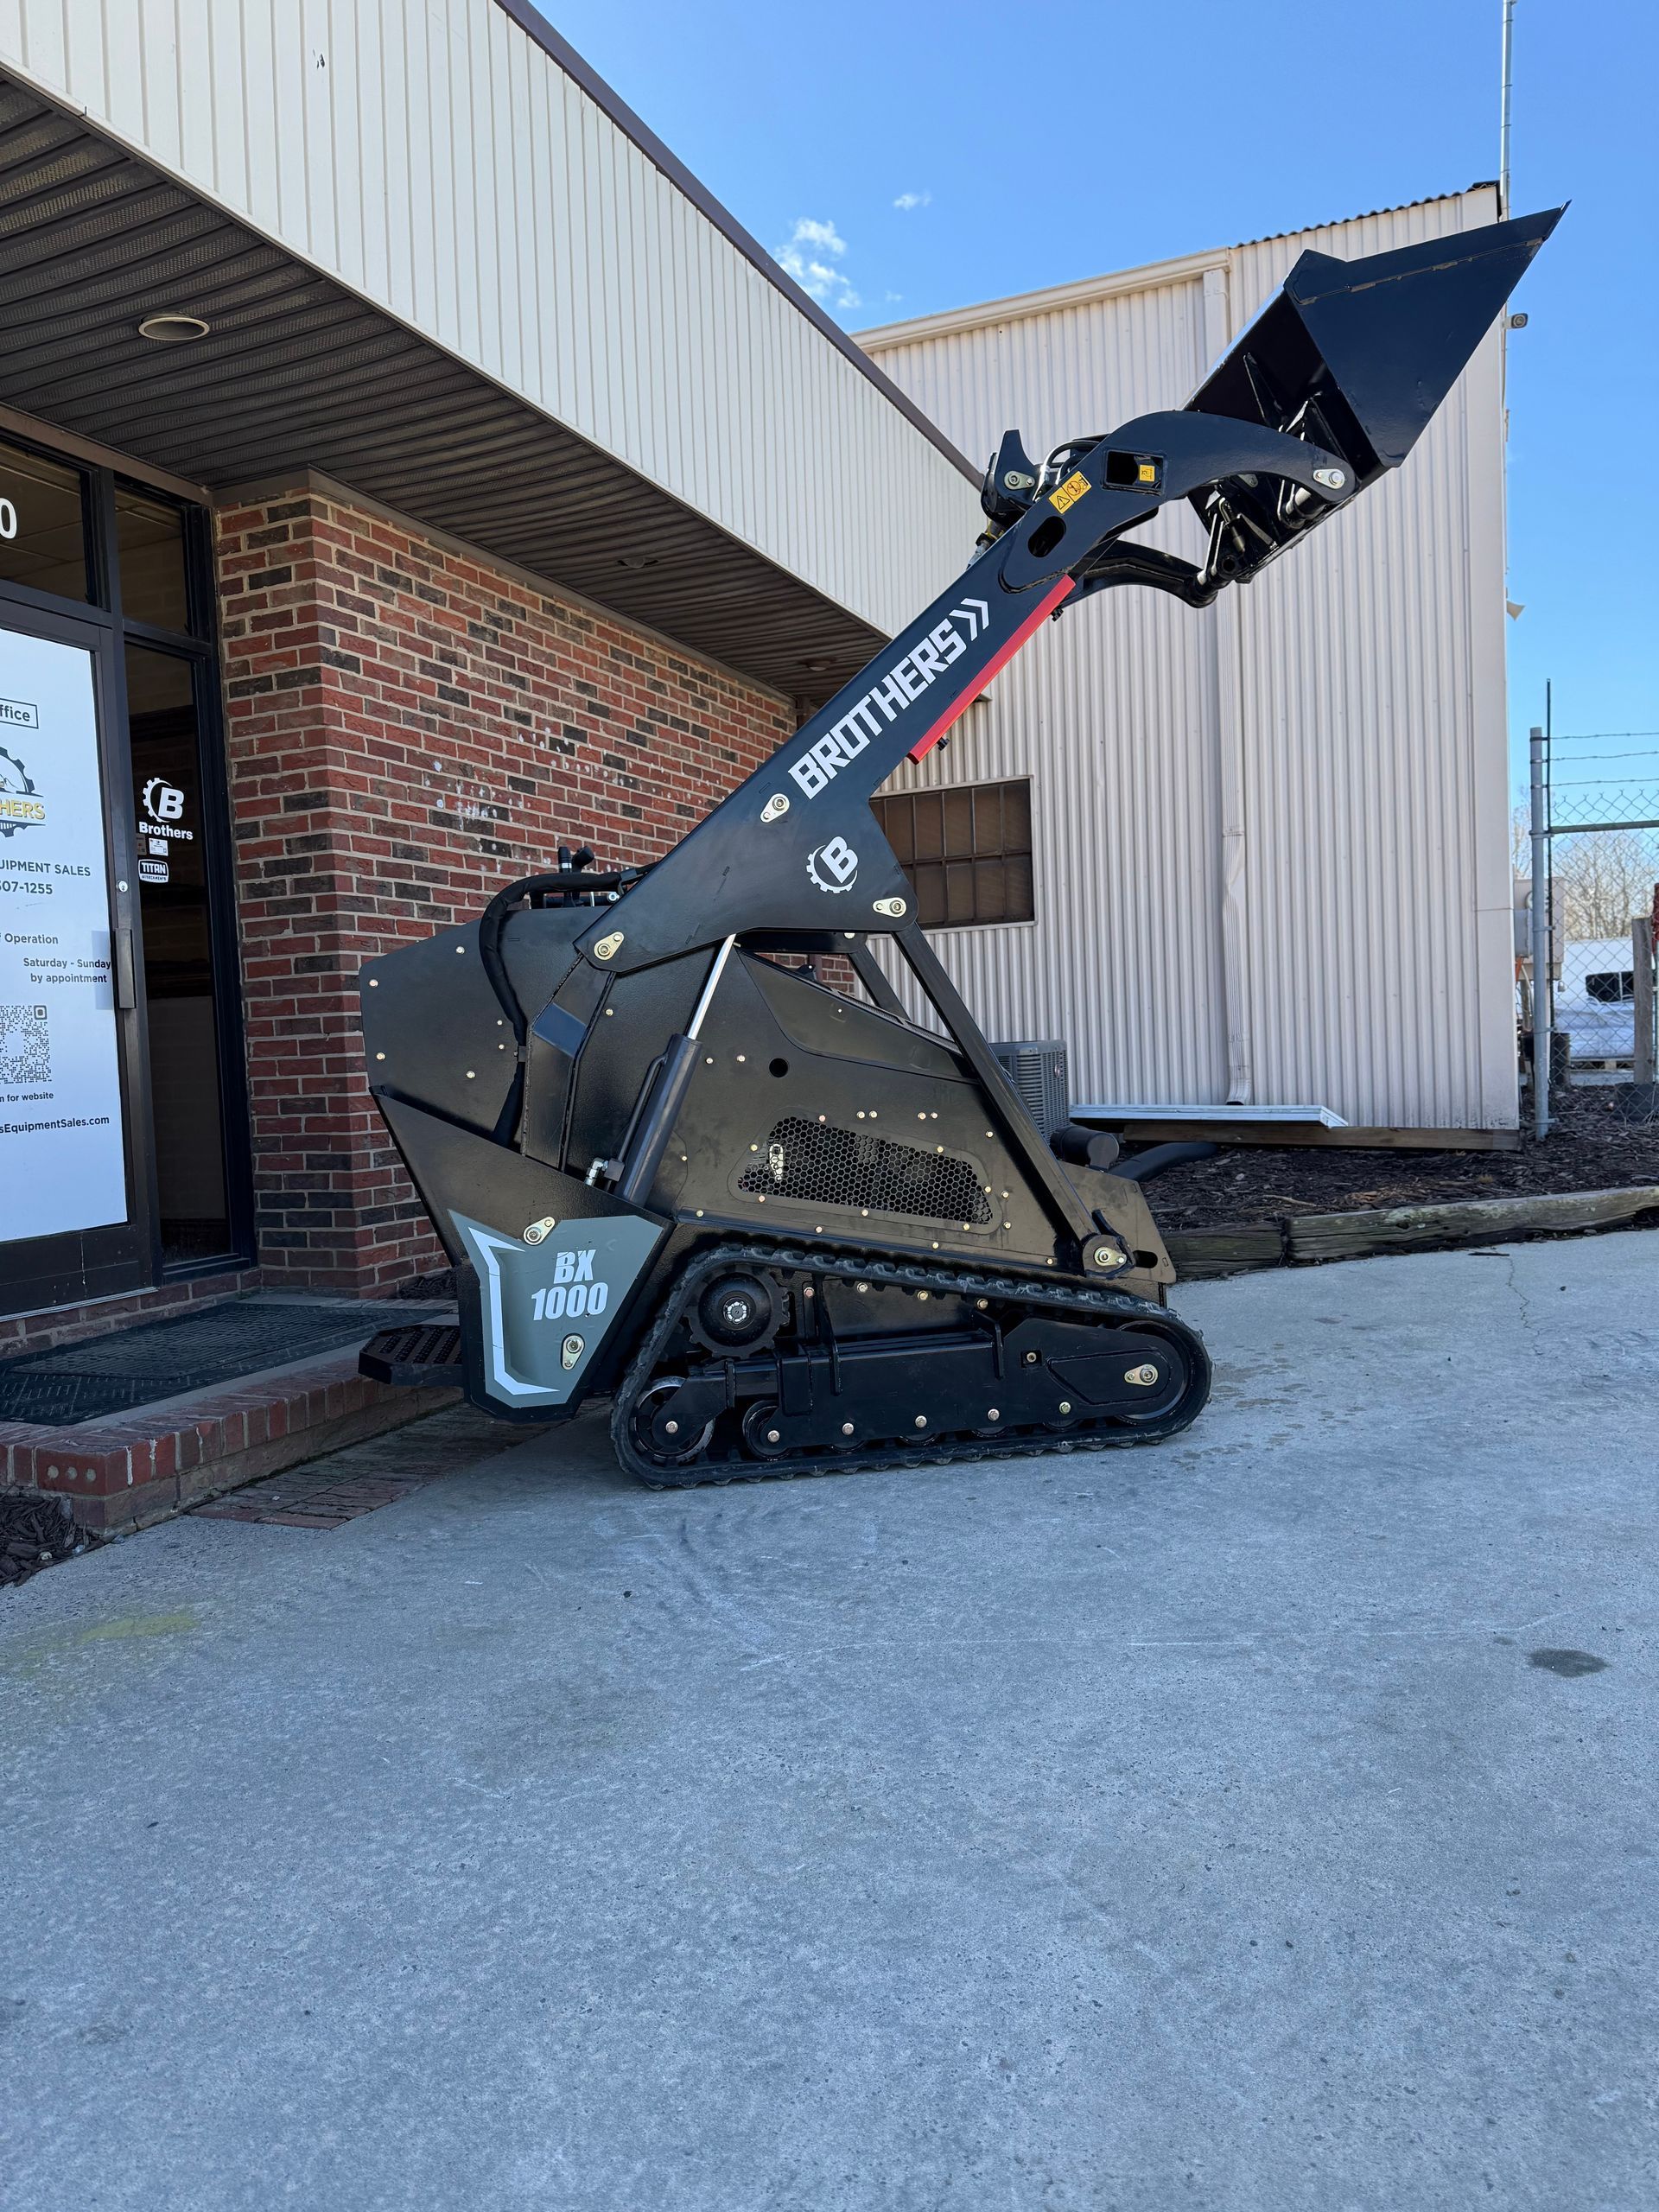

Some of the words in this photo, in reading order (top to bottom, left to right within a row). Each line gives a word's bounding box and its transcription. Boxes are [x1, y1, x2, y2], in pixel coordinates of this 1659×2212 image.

[0, 498, 17, 539] 0
[787, 618, 967, 800] BROTHERS
[138, 822, 194, 841] Brothers
[54, 864, 91, 877] SALES
[141, 862, 167, 874] TITAN
[0, 880, 53, 894] 07-1255
[4, 933, 59, 944] Operation
[23, 957, 67, 969] Saturday
[77, 959, 111, 969] Sunday
[30, 973, 43, 983] by
[46, 973, 107, 983] appointment
[7, 1094, 19, 1103] for
[22, 1091, 54, 1101] website
[553, 1249, 596, 1284] BX
[531, 1282, 608, 1320] 1000
